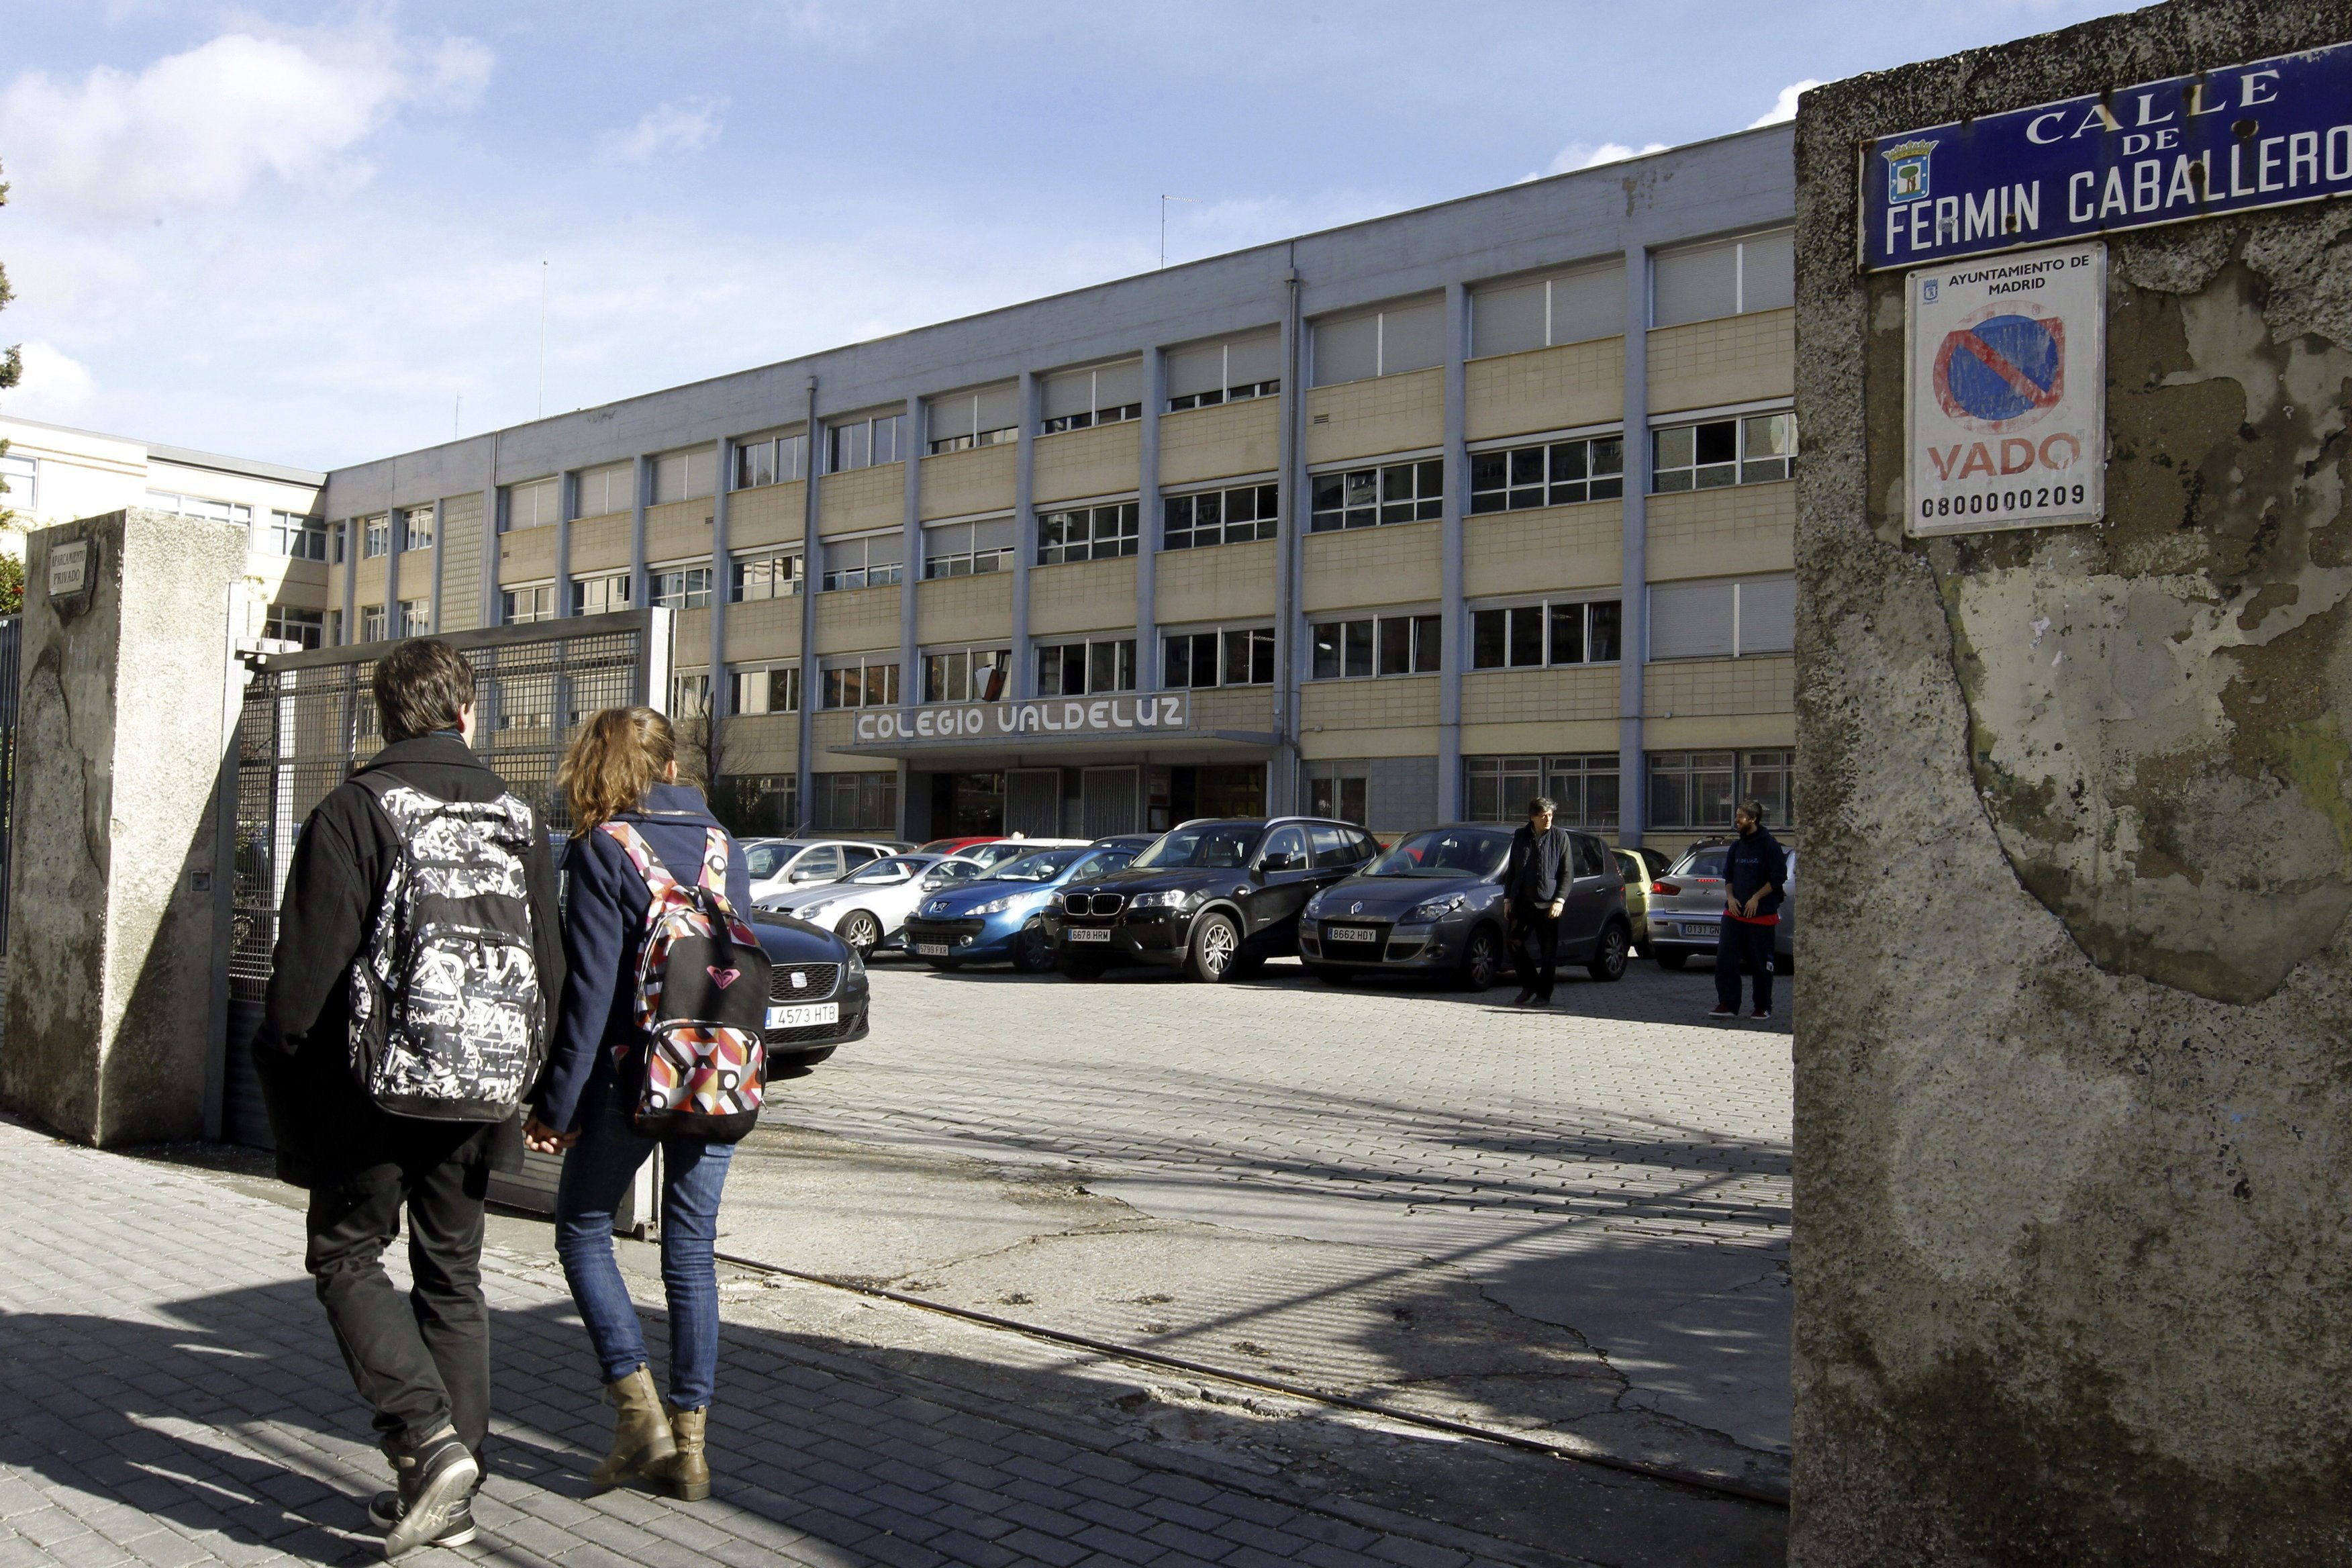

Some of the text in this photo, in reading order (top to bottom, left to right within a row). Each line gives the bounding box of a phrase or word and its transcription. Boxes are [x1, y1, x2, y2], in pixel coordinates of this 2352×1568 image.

[2026, 69, 2281, 145] CALLE
[2122, 128, 2179, 156] DE
[1886, 124, 2352, 255] FERMIN CABALLERO
[1949, 254, 2090, 287] AYUNTAMIENTO DE
[1989, 277, 2046, 296] MADRID
[1927, 432, 2081, 481] VADO
[1922, 484, 2085, 518] 0800000209
[54, 569, 81, 585] PRIVADO
[858, 708, 983, 739] COLEGIO
[1073, 930, 1108, 940] 6678 HRM
[1334, 929, 1373, 940] 8662 HDY
[1687, 925, 1719, 934] 0131 GN
[779, 1006, 835, 1024] 4573 HTB
